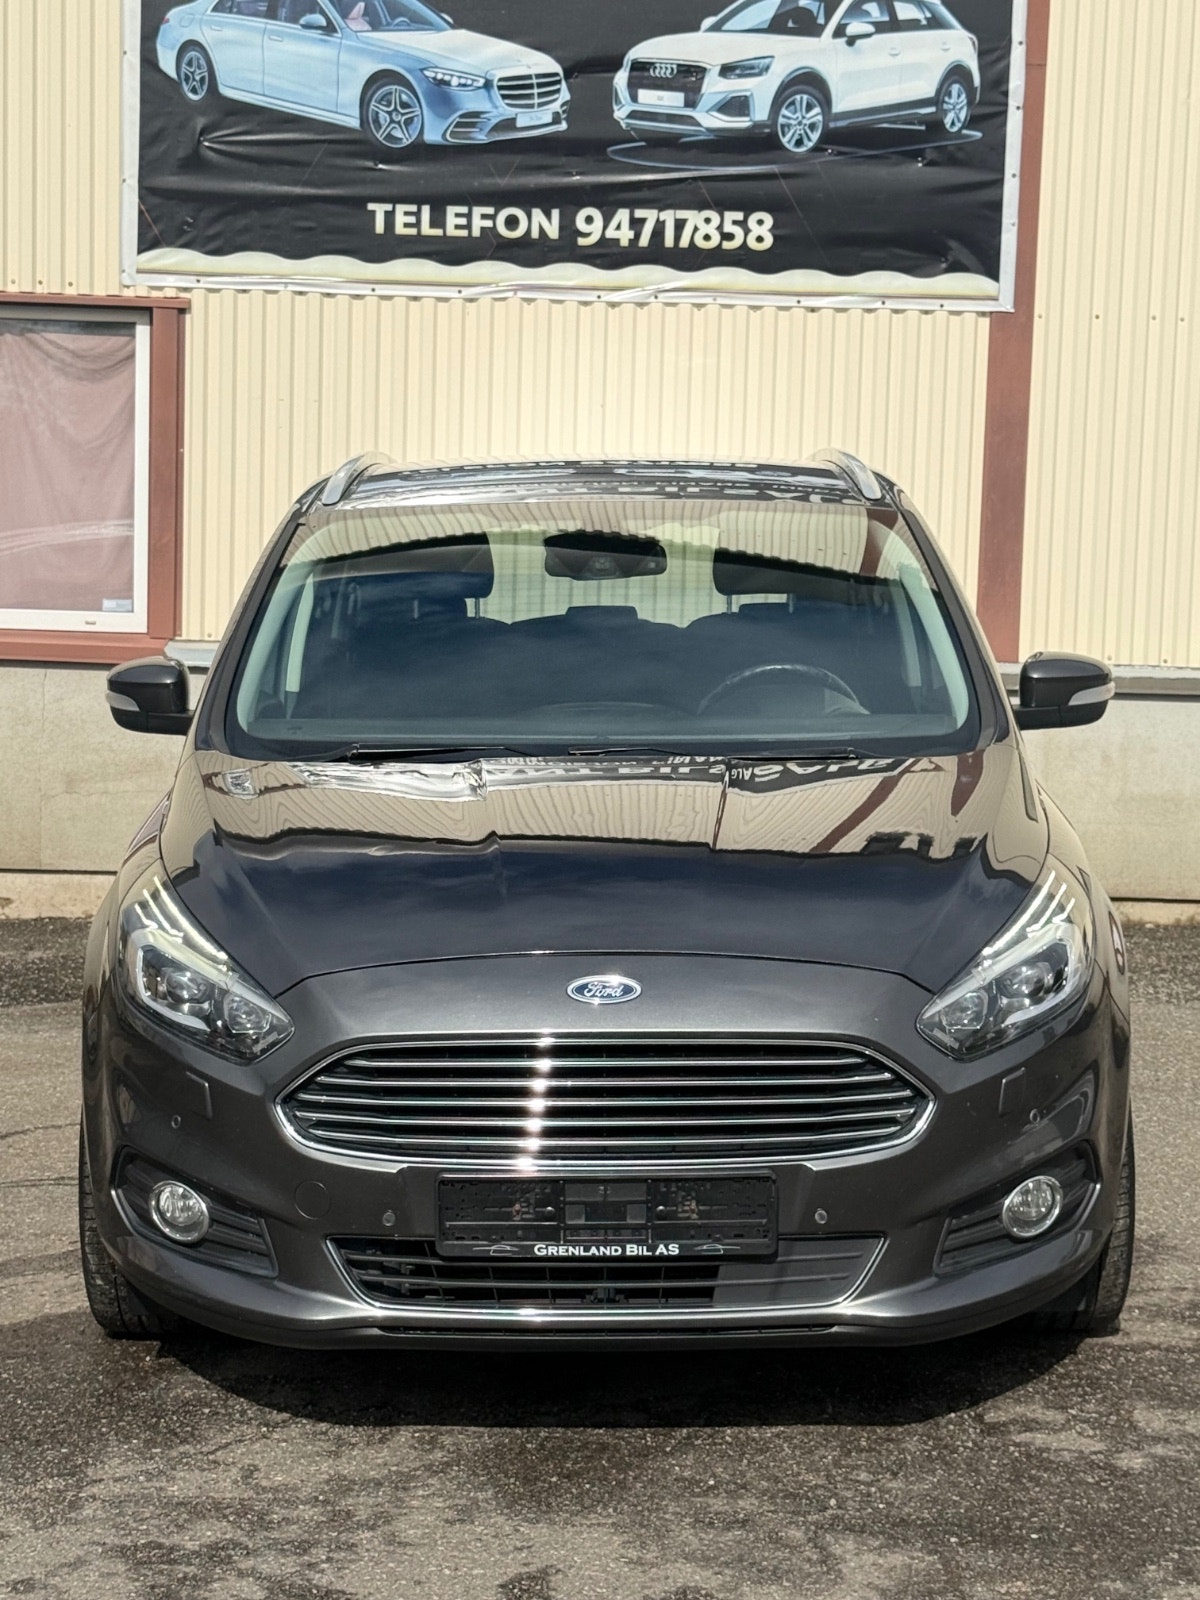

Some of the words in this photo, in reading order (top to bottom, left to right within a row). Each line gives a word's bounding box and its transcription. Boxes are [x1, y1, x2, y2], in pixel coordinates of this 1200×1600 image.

[367, 203, 559, 240] TELEFON
[575, 206, 774, 251] 94717858
[583, 981, 624, 997] Ford
[534, 1243, 622, 1256] GRENLAND
[625, 1243, 652, 1256] BIL
[655, 1243, 680, 1256] AS
